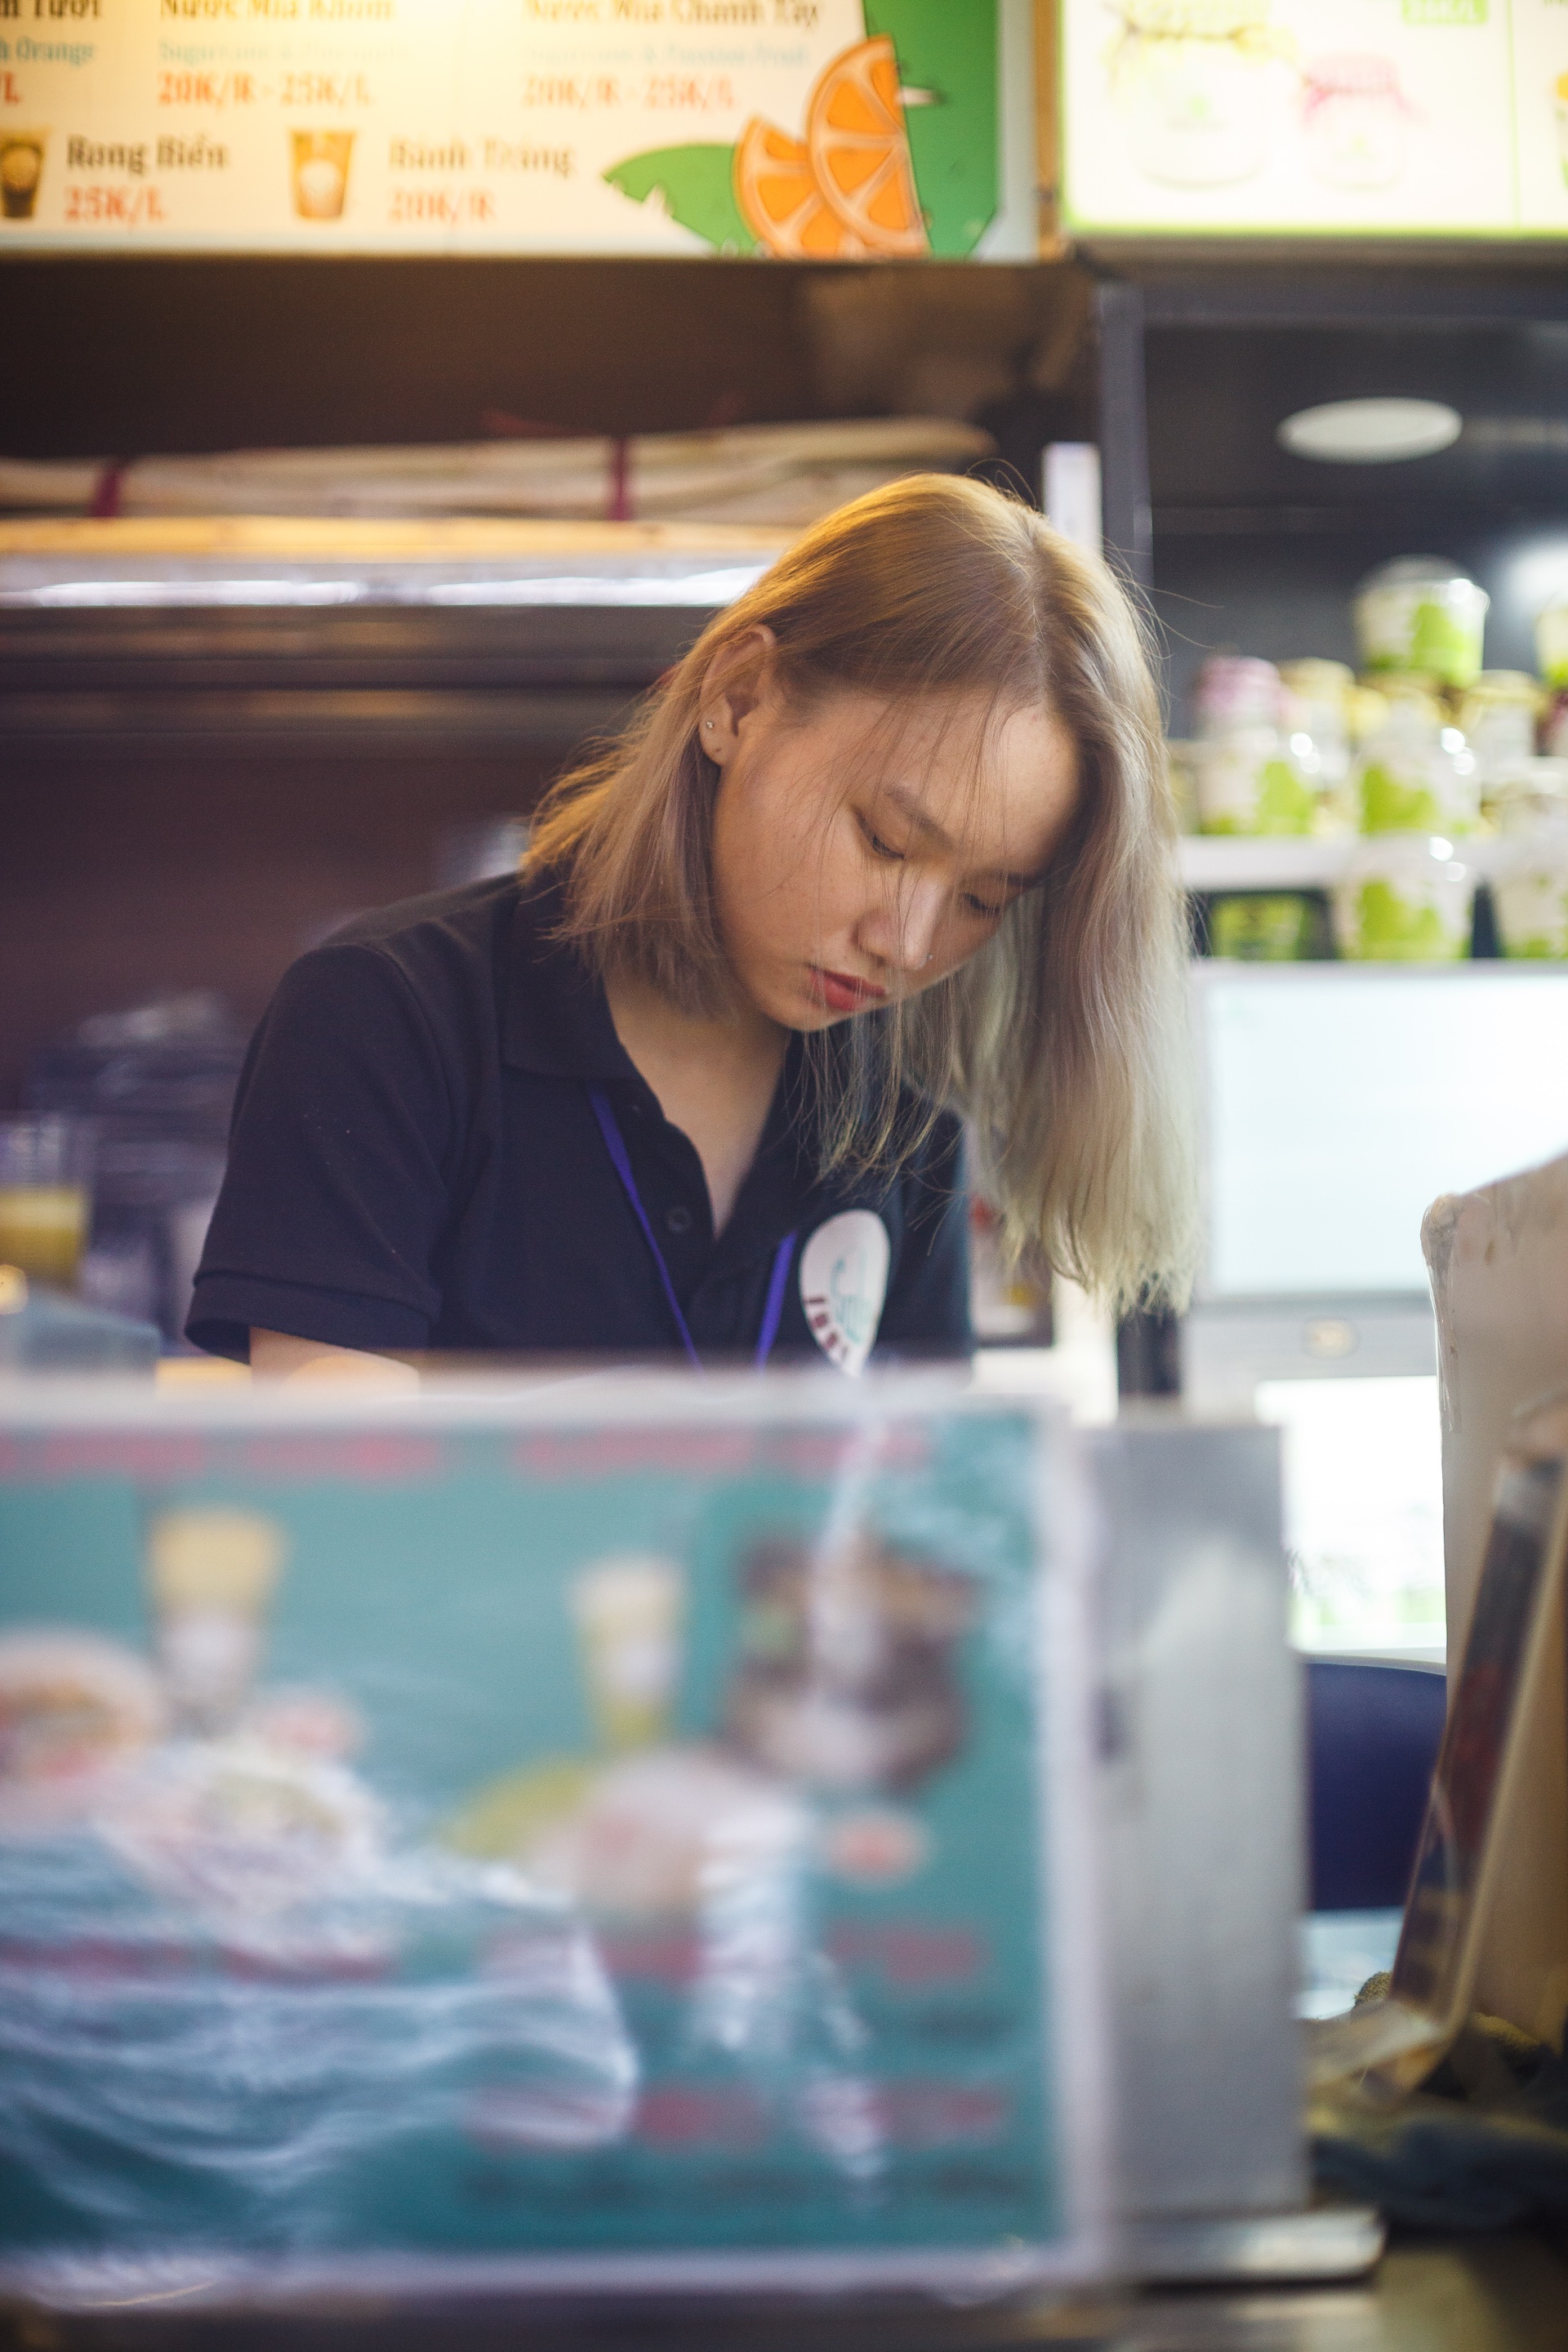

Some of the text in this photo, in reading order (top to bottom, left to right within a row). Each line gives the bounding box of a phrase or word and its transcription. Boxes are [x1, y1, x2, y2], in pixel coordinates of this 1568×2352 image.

[16, 38, 96, 65] Orange
[67, 135, 147, 177] Rong
[65, 186, 166, 226] 25K/L
